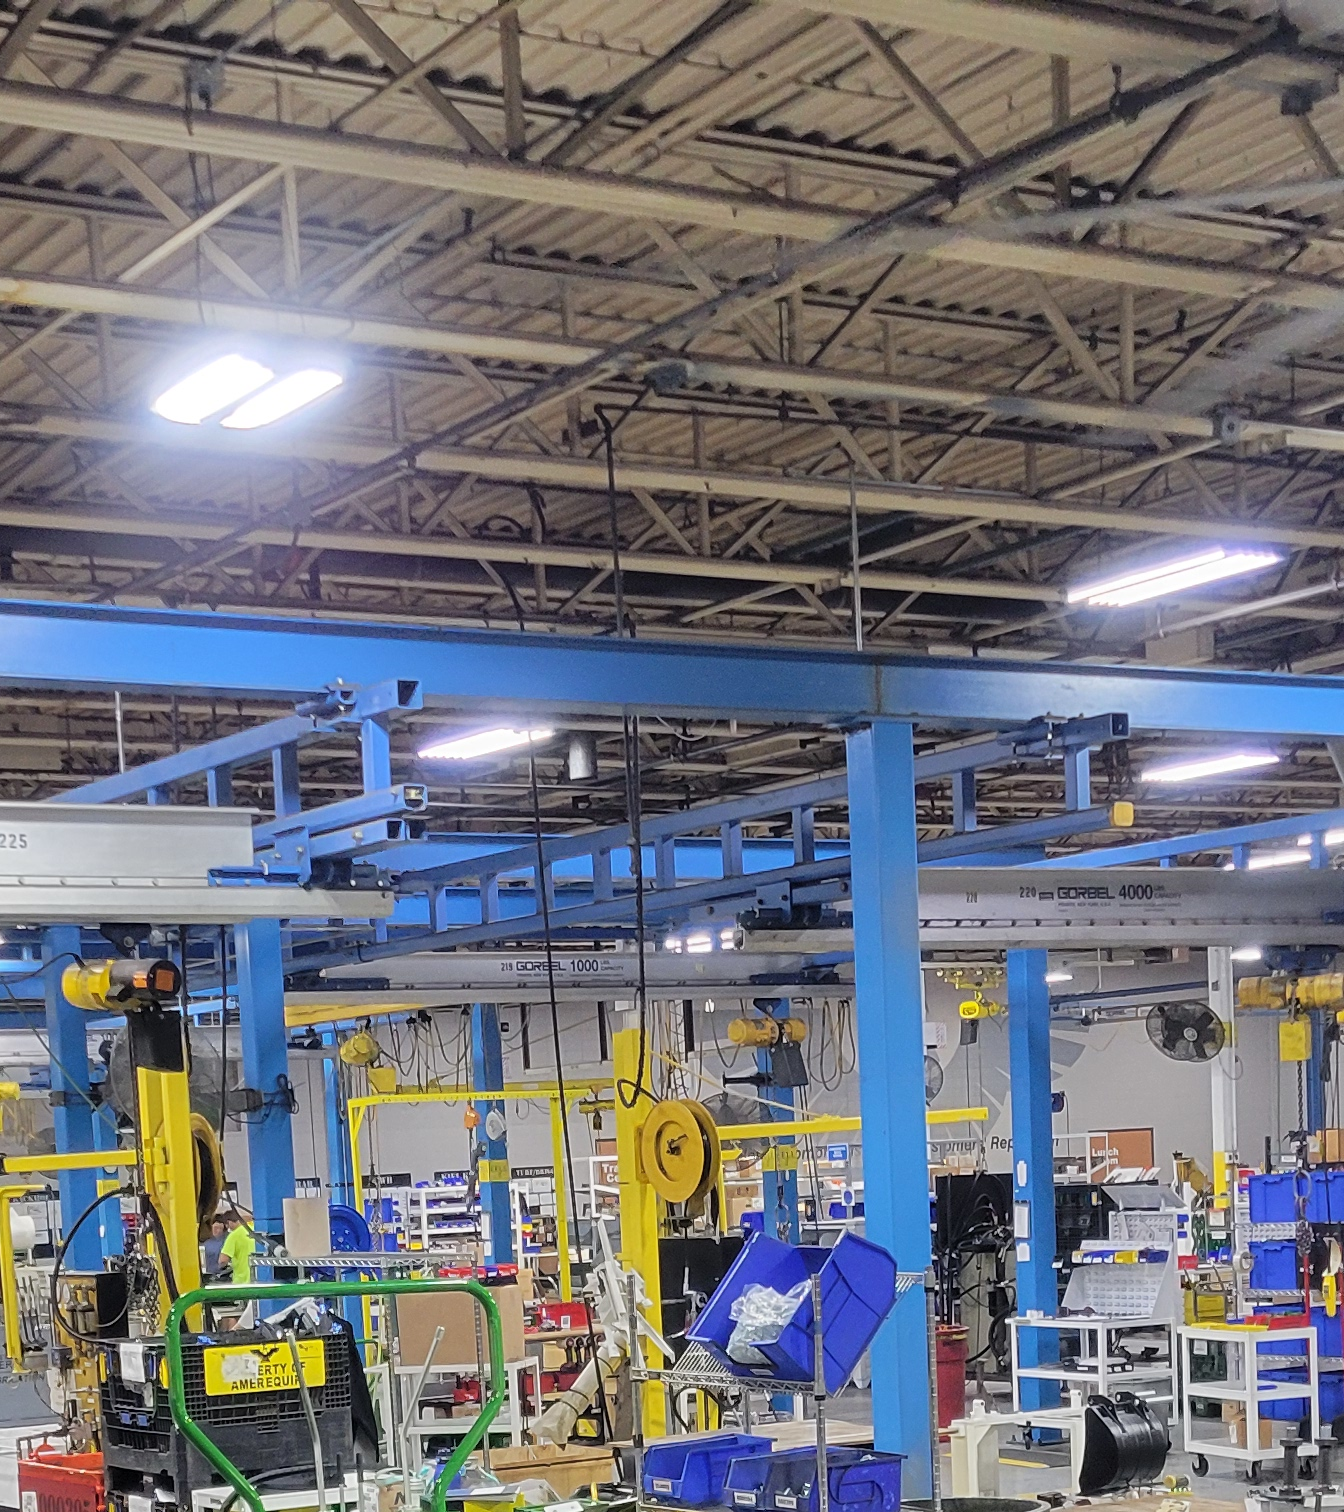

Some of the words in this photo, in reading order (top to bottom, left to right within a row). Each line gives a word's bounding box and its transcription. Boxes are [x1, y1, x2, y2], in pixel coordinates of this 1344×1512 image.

[1019, 886, 1037, 898] 220
[1057, 887, 1116, 900] GORBEL
[1118, 884, 1154, 900] 4000
[570, 959, 599, 972] 1000
